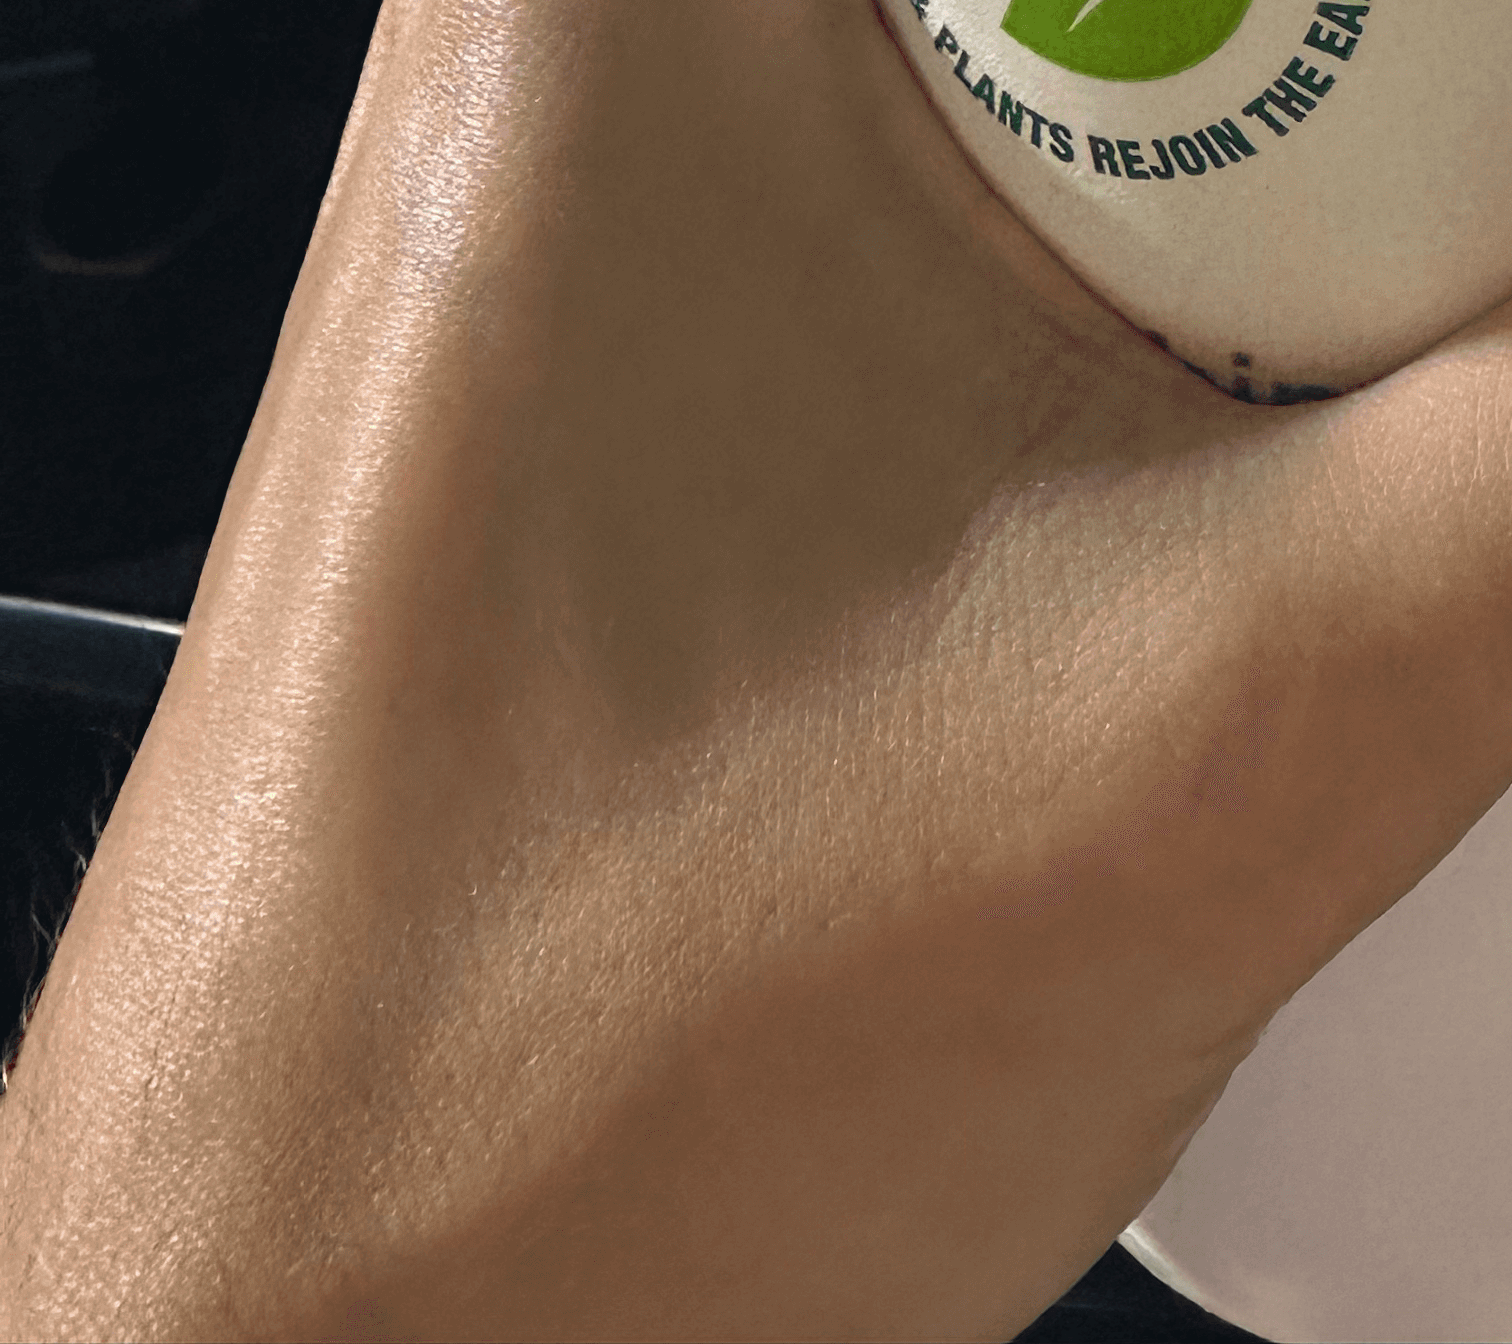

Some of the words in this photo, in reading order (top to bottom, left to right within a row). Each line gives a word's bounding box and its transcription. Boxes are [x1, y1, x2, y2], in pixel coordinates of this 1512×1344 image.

[934, 24, 1074, 163] PLANTS
[1089, 116, 1259, 181] REJOIN
[1242, 56, 1336, 138] THE
